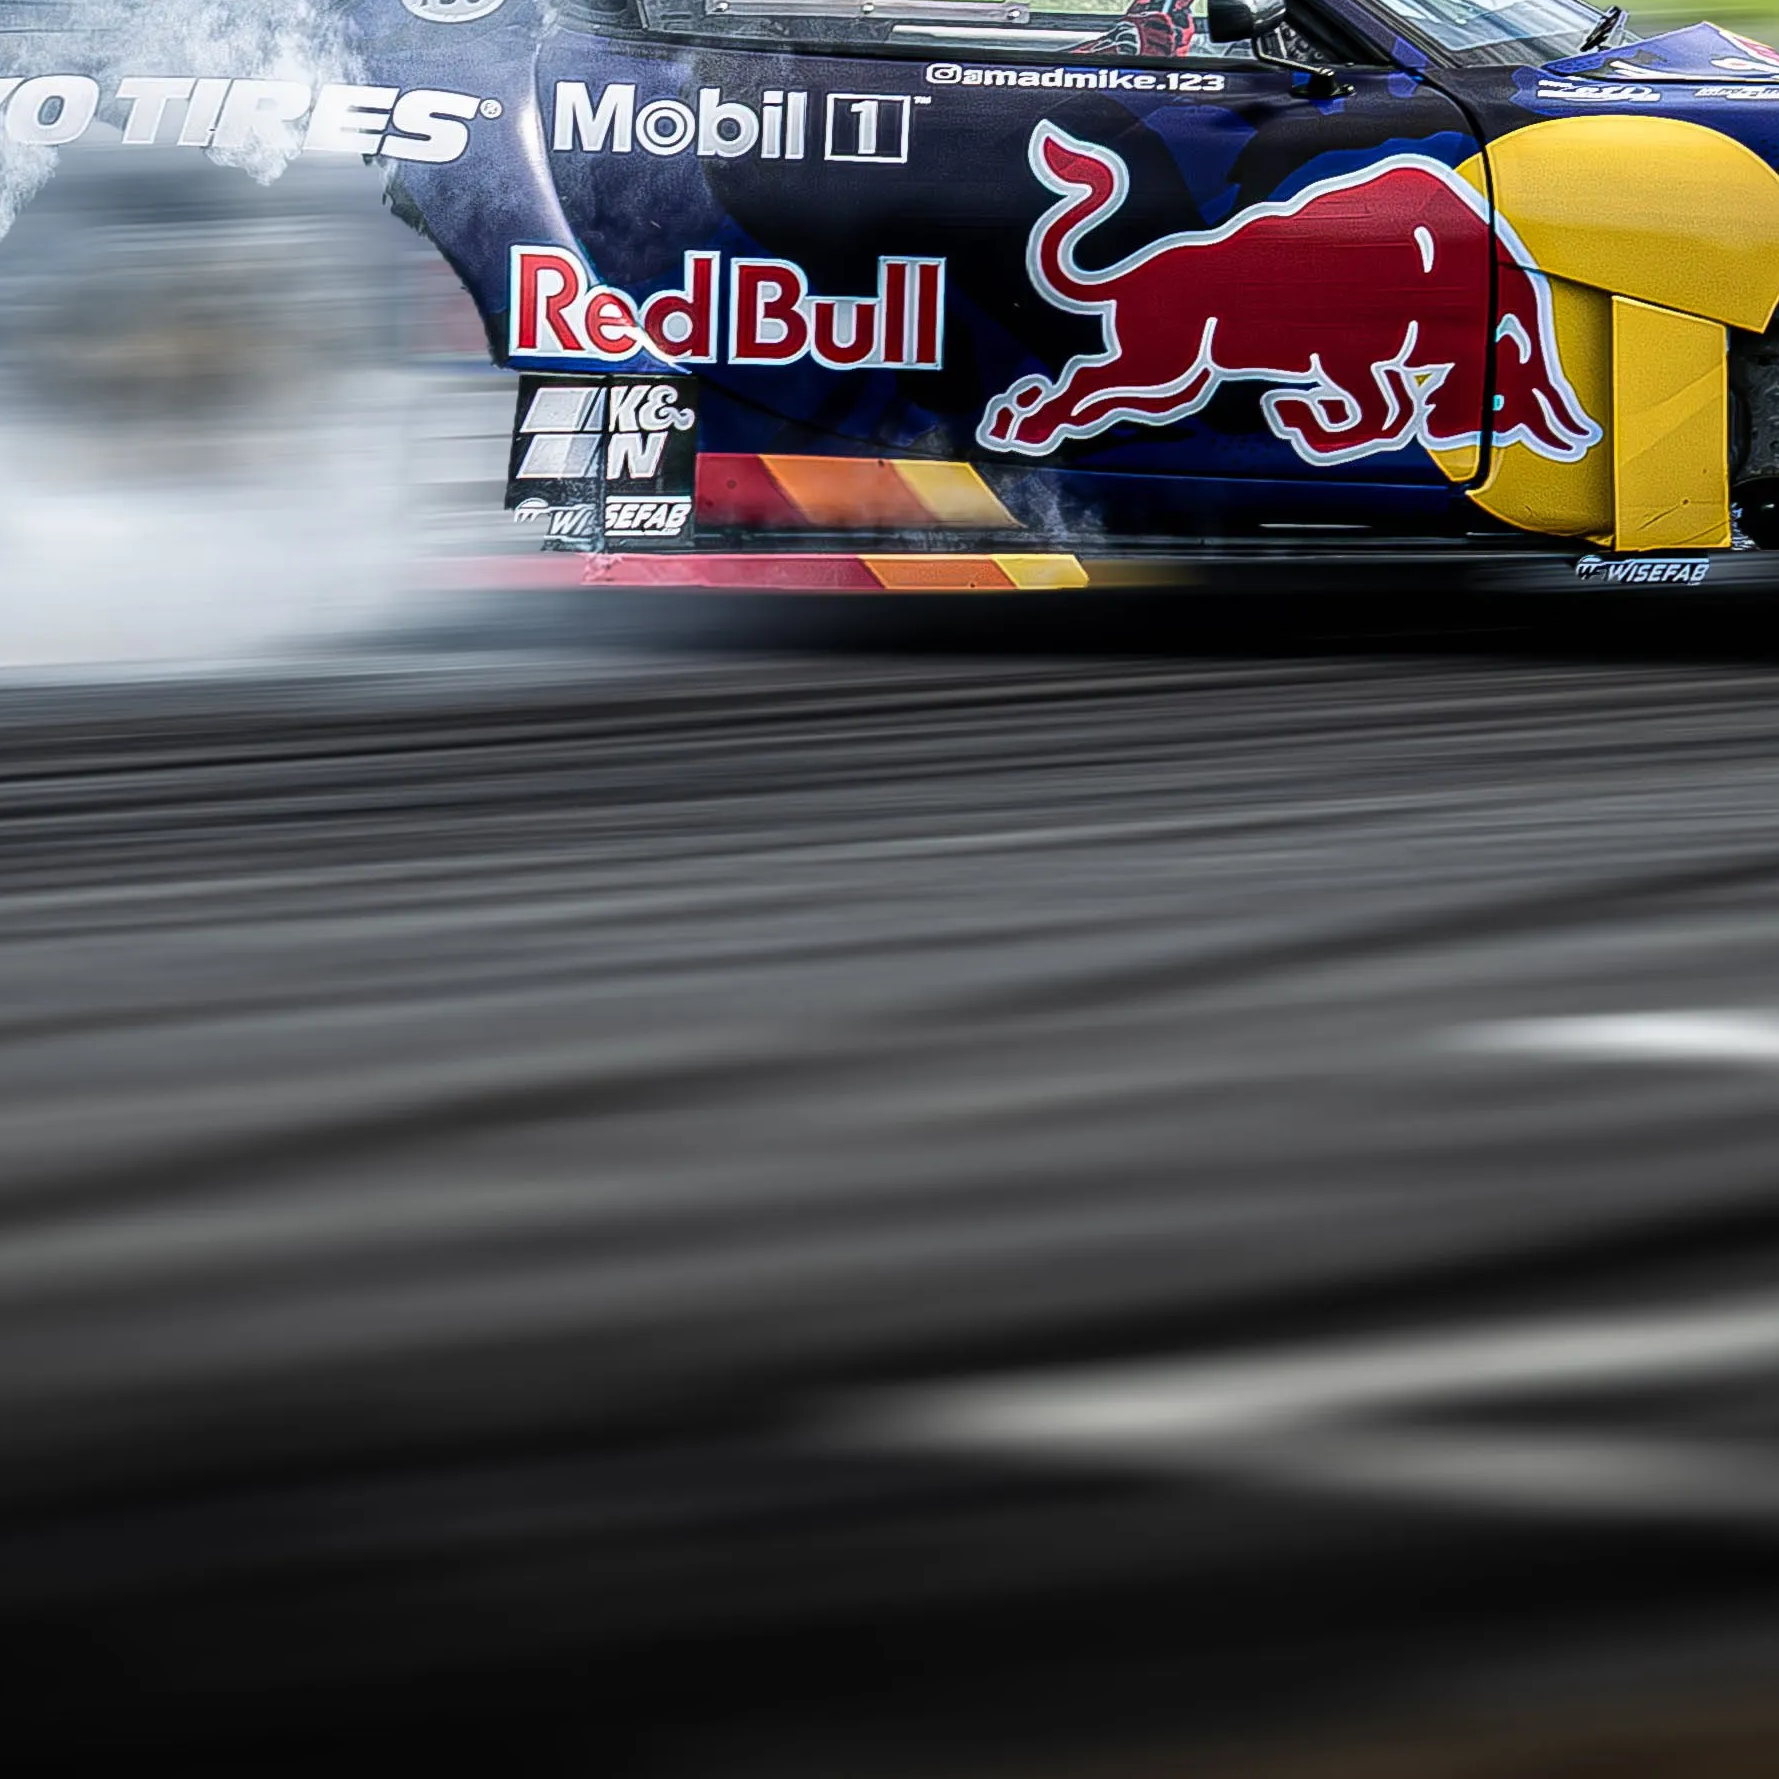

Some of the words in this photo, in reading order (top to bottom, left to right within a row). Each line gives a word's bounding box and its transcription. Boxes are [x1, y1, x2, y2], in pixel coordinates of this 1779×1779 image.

[115, 77, 482, 164] TIRES
[553, 80, 808, 160] Mobil
[509, 245, 720, 365] Red
[729, 256, 947, 371] Bull
[1607, 563, 1710, 583] WISEFAB
